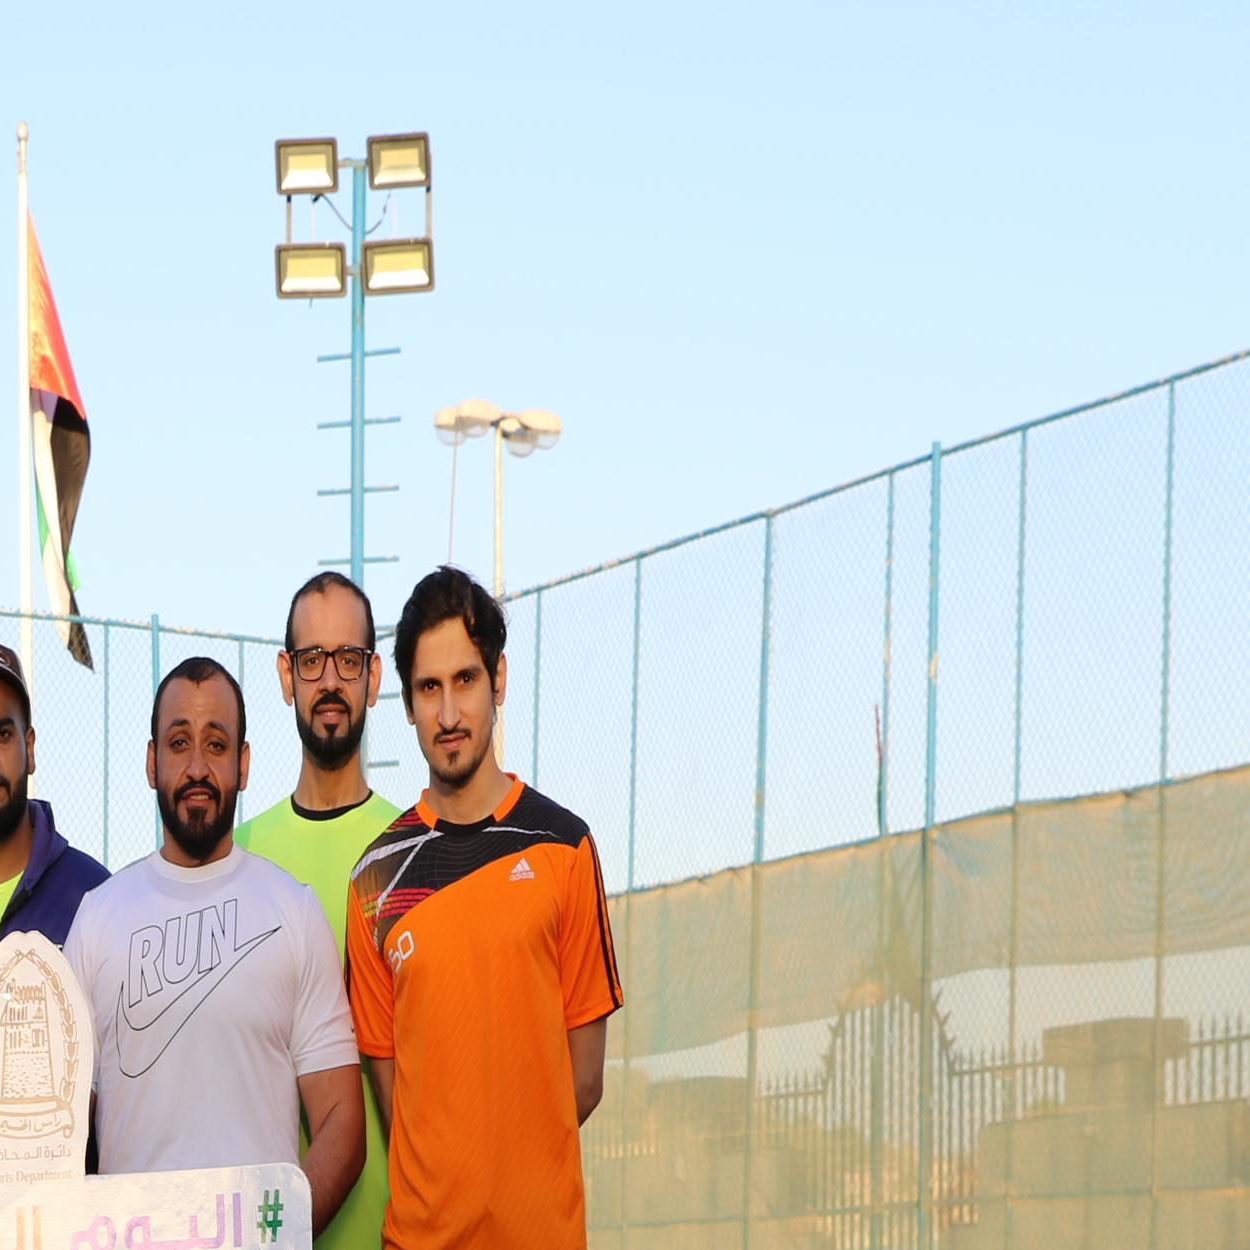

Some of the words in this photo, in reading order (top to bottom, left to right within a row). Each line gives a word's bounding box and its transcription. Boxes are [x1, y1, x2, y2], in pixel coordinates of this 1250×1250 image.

[509, 870, 535, 881] adidas
[129, 898, 238, 1009] RUN
[15, 1169, 73, 1185] Department
